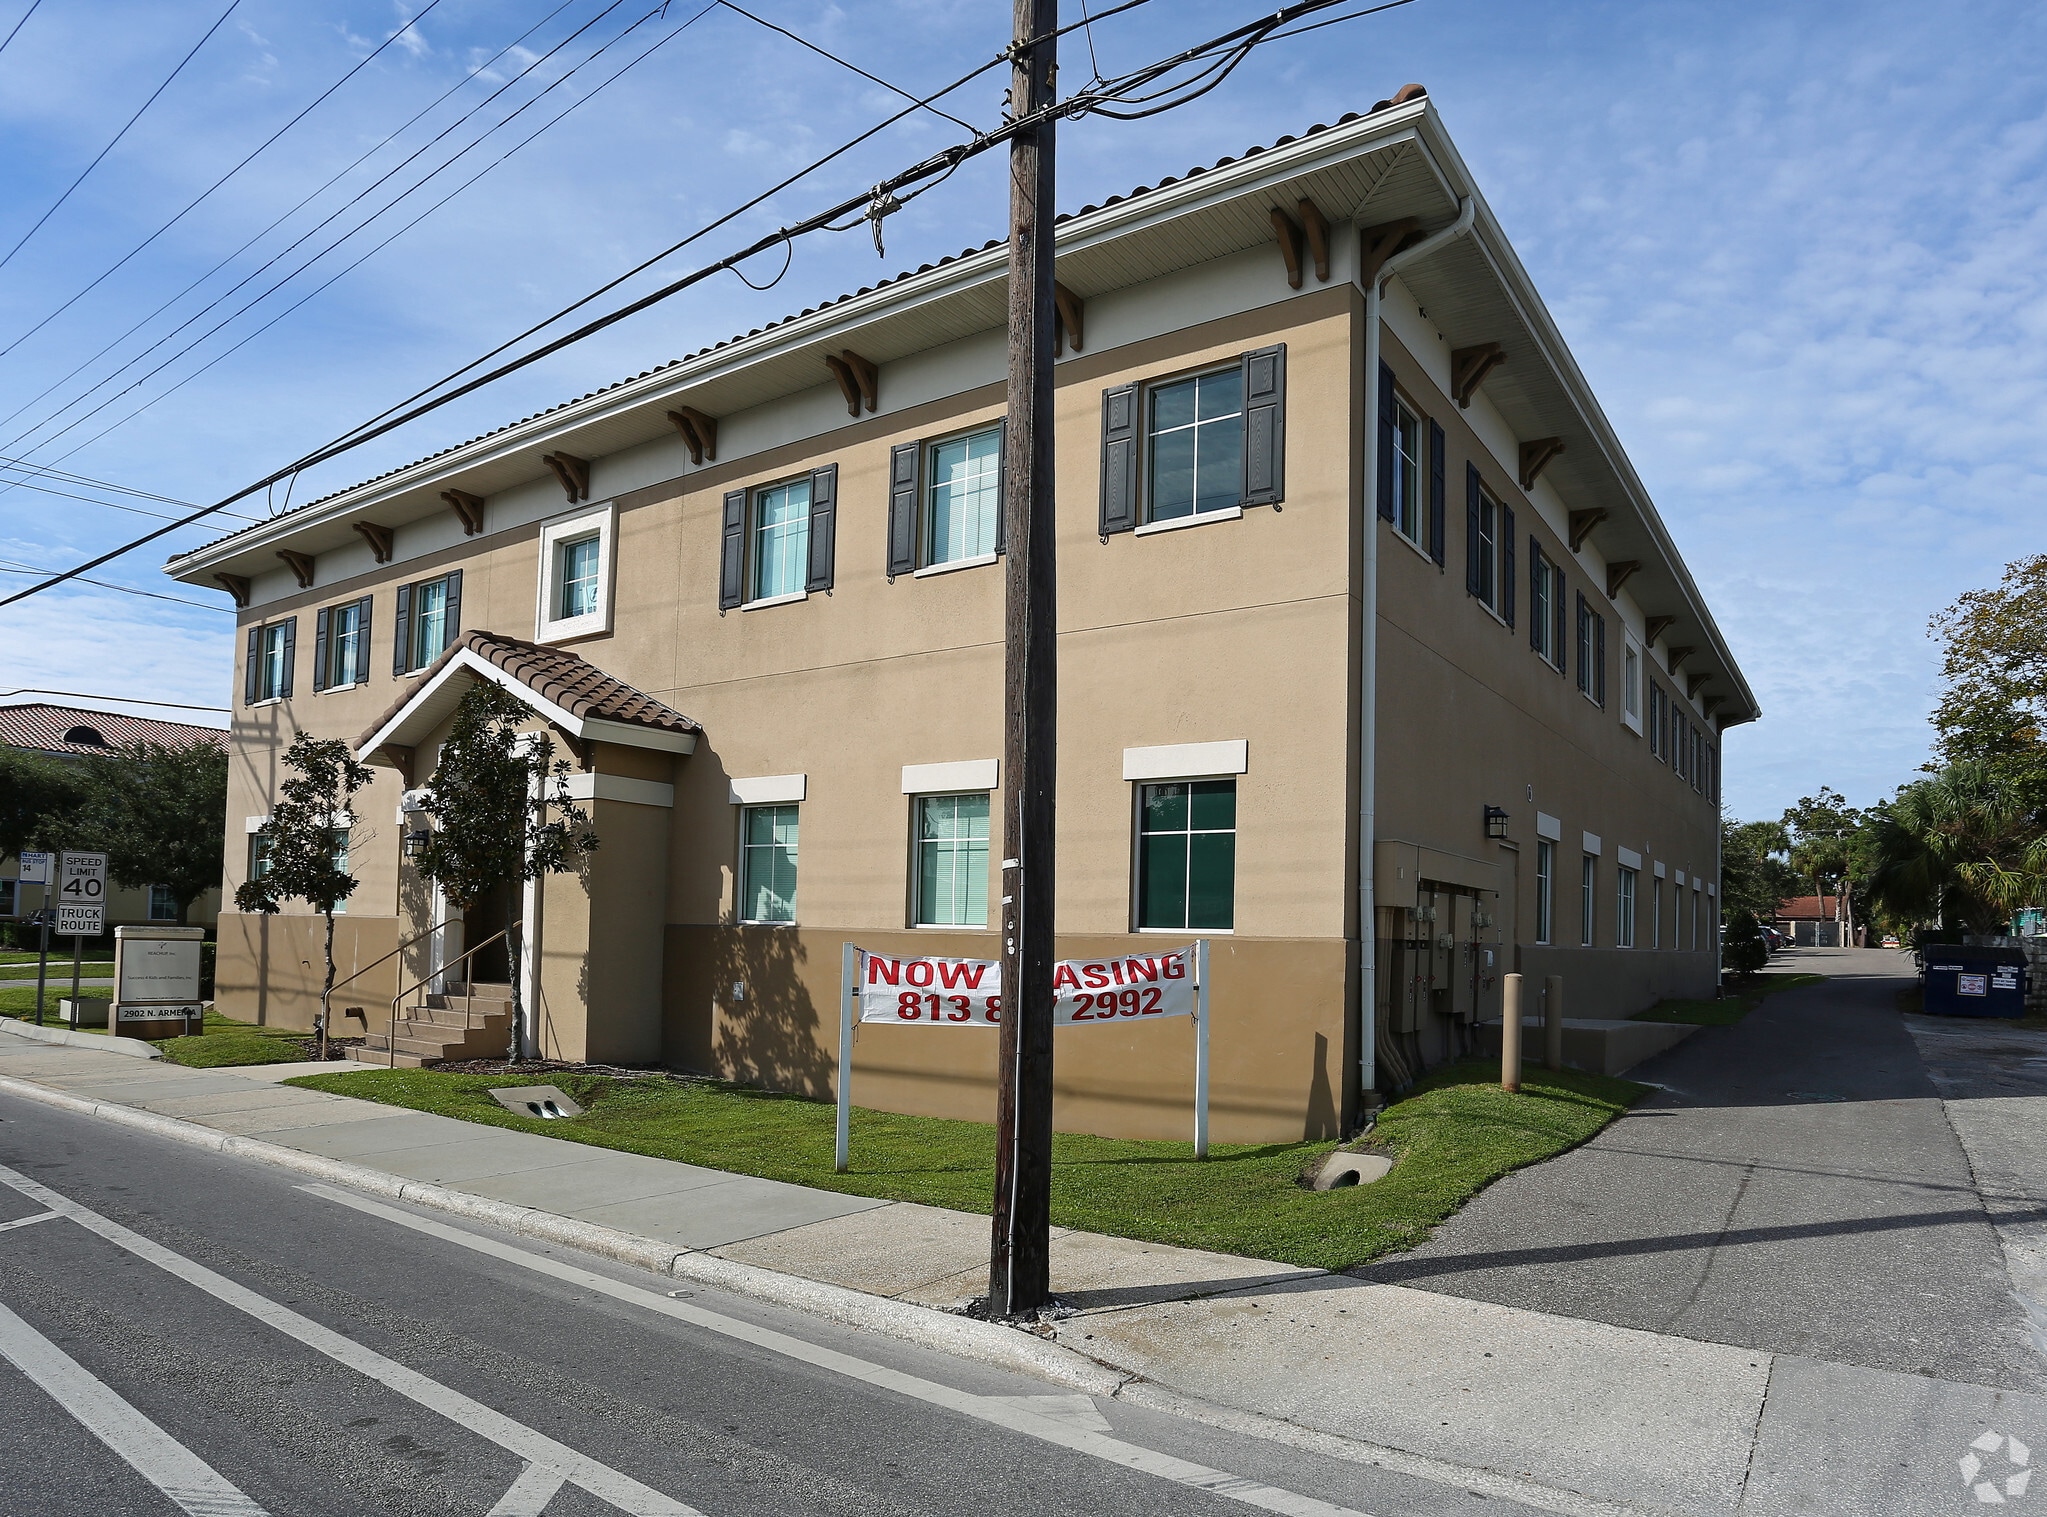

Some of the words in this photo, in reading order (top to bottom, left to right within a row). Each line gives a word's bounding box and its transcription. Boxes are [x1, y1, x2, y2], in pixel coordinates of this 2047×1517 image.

[66, 857, 102, 866] SPEED
[22, 864, 31, 872] 14
[69, 867, 98, 876] LIMIT
[63, 878, 102, 897] 40
[60, 908, 100, 919] TRUCK
[60, 920, 100, 931] ROUTE
[868, 955, 986, 990] NOW
[1053, 953, 1186, 990] ASING
[897, 991, 971, 1022] 813
[1071, 987, 1163, 1021] 2992
[124, 1010, 145, 1018] 2902
[147, 1009, 156, 1017] N.
